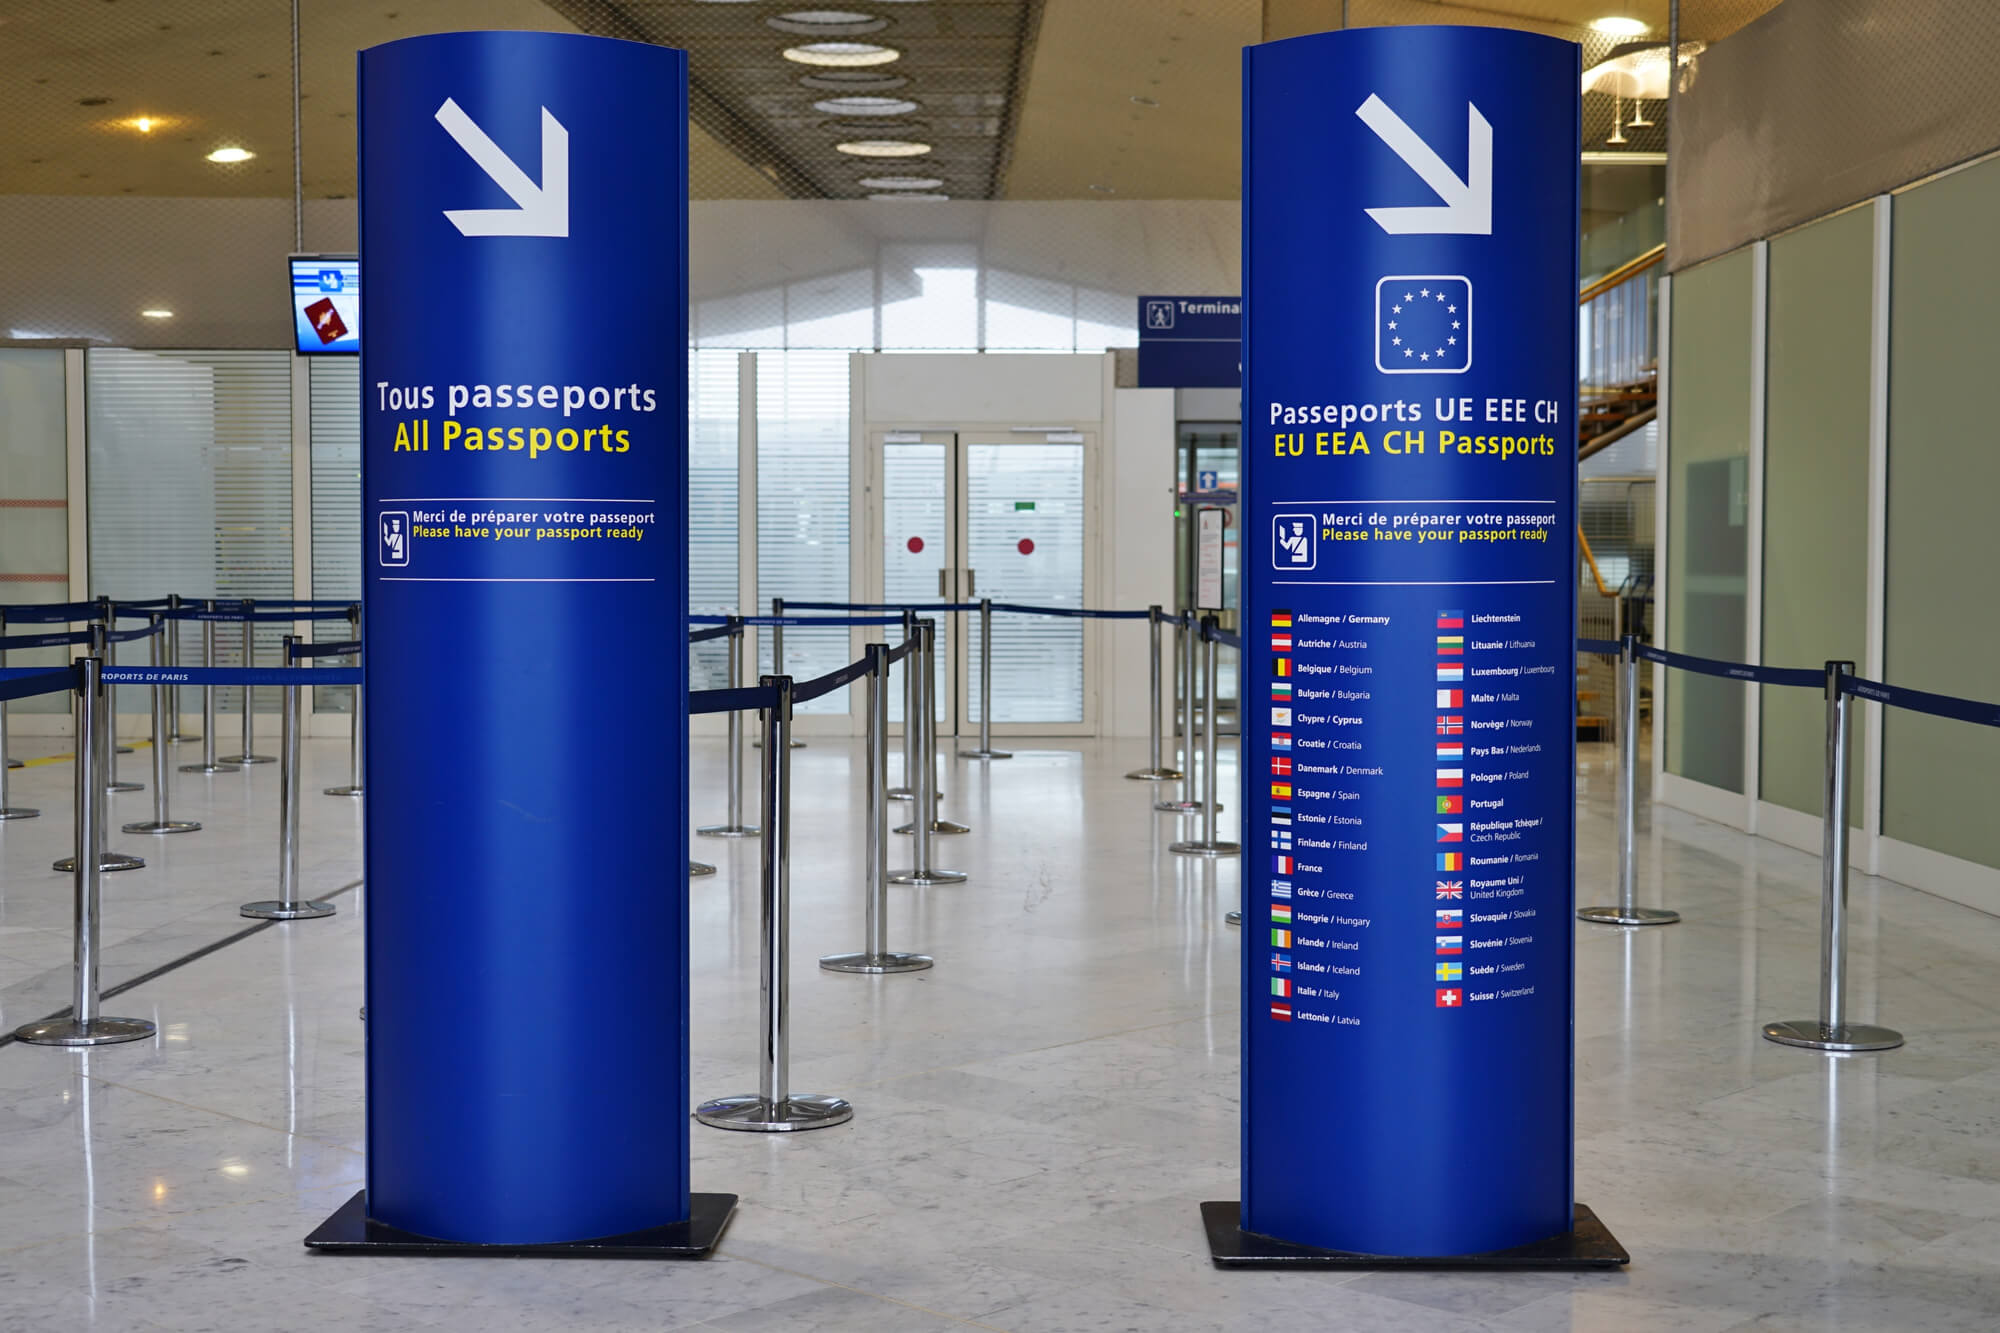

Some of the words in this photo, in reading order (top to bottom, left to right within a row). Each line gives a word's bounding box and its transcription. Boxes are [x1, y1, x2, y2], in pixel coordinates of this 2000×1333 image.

[377, 382, 434, 411] Tous
[449, 383, 656, 417] passeports
[1271, 400, 1421, 429] Passeports
[1436, 398, 1473, 421] UE
[1486, 398, 1526, 422] EEE
[1534, 400, 1558, 424] CH
[394, 419, 428, 452] All
[443, 420, 630, 459] Passports
[1275, 433, 1304, 456] EU
[1316, 431, 1370, 455] EEA
[1383, 430, 1424, 454] CH
[1440, 430, 1554, 460] Passports
[413, 510, 445, 522] Merci
[449, 510, 466, 522] de
[471, 510, 538, 526] préparer
[544, 512, 584, 523] votre
[590, 513, 655, 526] passeport
[1323, 512, 1362, 526] Merci
[1368, 512, 1387, 525] de
[1393, 512, 1462, 528] préparer
[1466, 513, 1502, 525] votre
[1507, 514, 1555, 528] passeport
[413, 525, 450, 538] Please
[455, 524, 489, 538] have
[494, 528, 531, 541] your
[536, 527, 602, 541] passport
[607, 526, 644, 541] ready
[1322, 528, 1368, 540] Please
[1374, 527, 1412, 540] have
[1418, 530, 1454, 544] your
[1459, 529, 1516, 543] passport
[1520, 527, 1548, 543] ready
[1298, 614, 1340, 625] Allemagne
[1348, 614, 1390, 626] Germany
[1471, 614, 1521, 623] Liechtenstein
[1298, 639, 1331, 648] Autriche
[1338, 640, 1367, 649] Austria
[1471, 640, 1503, 650] Lituanie
[1509, 640, 1536, 649] Lithuania
[1298, 664, 1332, 675] Belgique
[1339, 665, 1372, 676] Belgium
[1471, 666, 1519, 677] Luxembourg
[1524, 665, 1555, 674] Luxembourg
[1298, 689, 1330, 700] Bulgarie
[1337, 690, 1370, 701] Bulgaria
[1471, 693, 1495, 702] Malte
[1501, 693, 1520, 701] Malta
[1297, 714, 1325, 725] Chypre
[1332, 715, 1363, 726] Cyprus
[1471, 720, 1504, 730] Norvège
[1510, 719, 1532, 728] Norway
[1297, 738, 1326, 748] Croatie
[1332, 740, 1362, 750] Croatia
[1470, 747, 1490, 757] Pays
[1491, 746, 1504, 755] Bas
[1510, 744, 1541, 754] Nederlands
[1298, 763, 1338, 774] Danemark
[1346, 766, 1383, 775] Denmark
[1470, 773, 1503, 783] Pologne
[1509, 770, 1529, 780] Poland
[1298, 788, 1330, 800] Espagne
[1338, 790, 1360, 801] Spain
[1470, 798, 1504, 809] Portugal
[1298, 813, 1326, 823] Estonie
[1333, 815, 1362, 825] Estonia
[1470, 821, 1513, 832] République
[1514, 818, 1539, 828] Tchèque
[1470, 833, 1493, 842] Czech
[1494, 831, 1521, 842] Republic
[1298, 838, 1331, 849] Finlande
[1338, 840, 1367, 851] Finland
[1470, 855, 1509, 865] Roumanie
[1514, 853, 1539, 862] Romania
[1298, 862, 1323, 873] France
[1470, 879, 1506, 890] Royaume
[1507, 876, 1520, 885] Uni
[1297, 887, 1320, 898] Grèce
[1326, 890, 1354, 900] Greece
[1470, 890, 1495, 900] United
[1496, 888, 1524, 899] Kingdom
[1297, 912, 1329, 924] Hongrie
[1336, 916, 1371, 928] Hungary
[1470, 912, 1508, 922] Slovaquie
[1513, 909, 1536, 919] Slovakia
[1297, 937, 1325, 948] Irlande
[1332, 940, 1359, 950] Ireland
[1470, 938, 1503, 949] Slovénie
[1509, 936, 1533, 946] Slovenia
[1297, 961, 1325, 972] Islande
[1332, 965, 1360, 976] Iceland
[1470, 965, 1494, 975] Suède
[1501, 962, 1525, 972] Sweden
[1297, 986, 1317, 996] Italie
[1324, 990, 1340, 1000] Italy
[1470, 992, 1494, 1001] Suisse
[1500, 986, 1534, 999] Switzerland
[1297, 1011, 1330, 1023] Lettonie
[1337, 1016, 1360, 1026] Latvia
